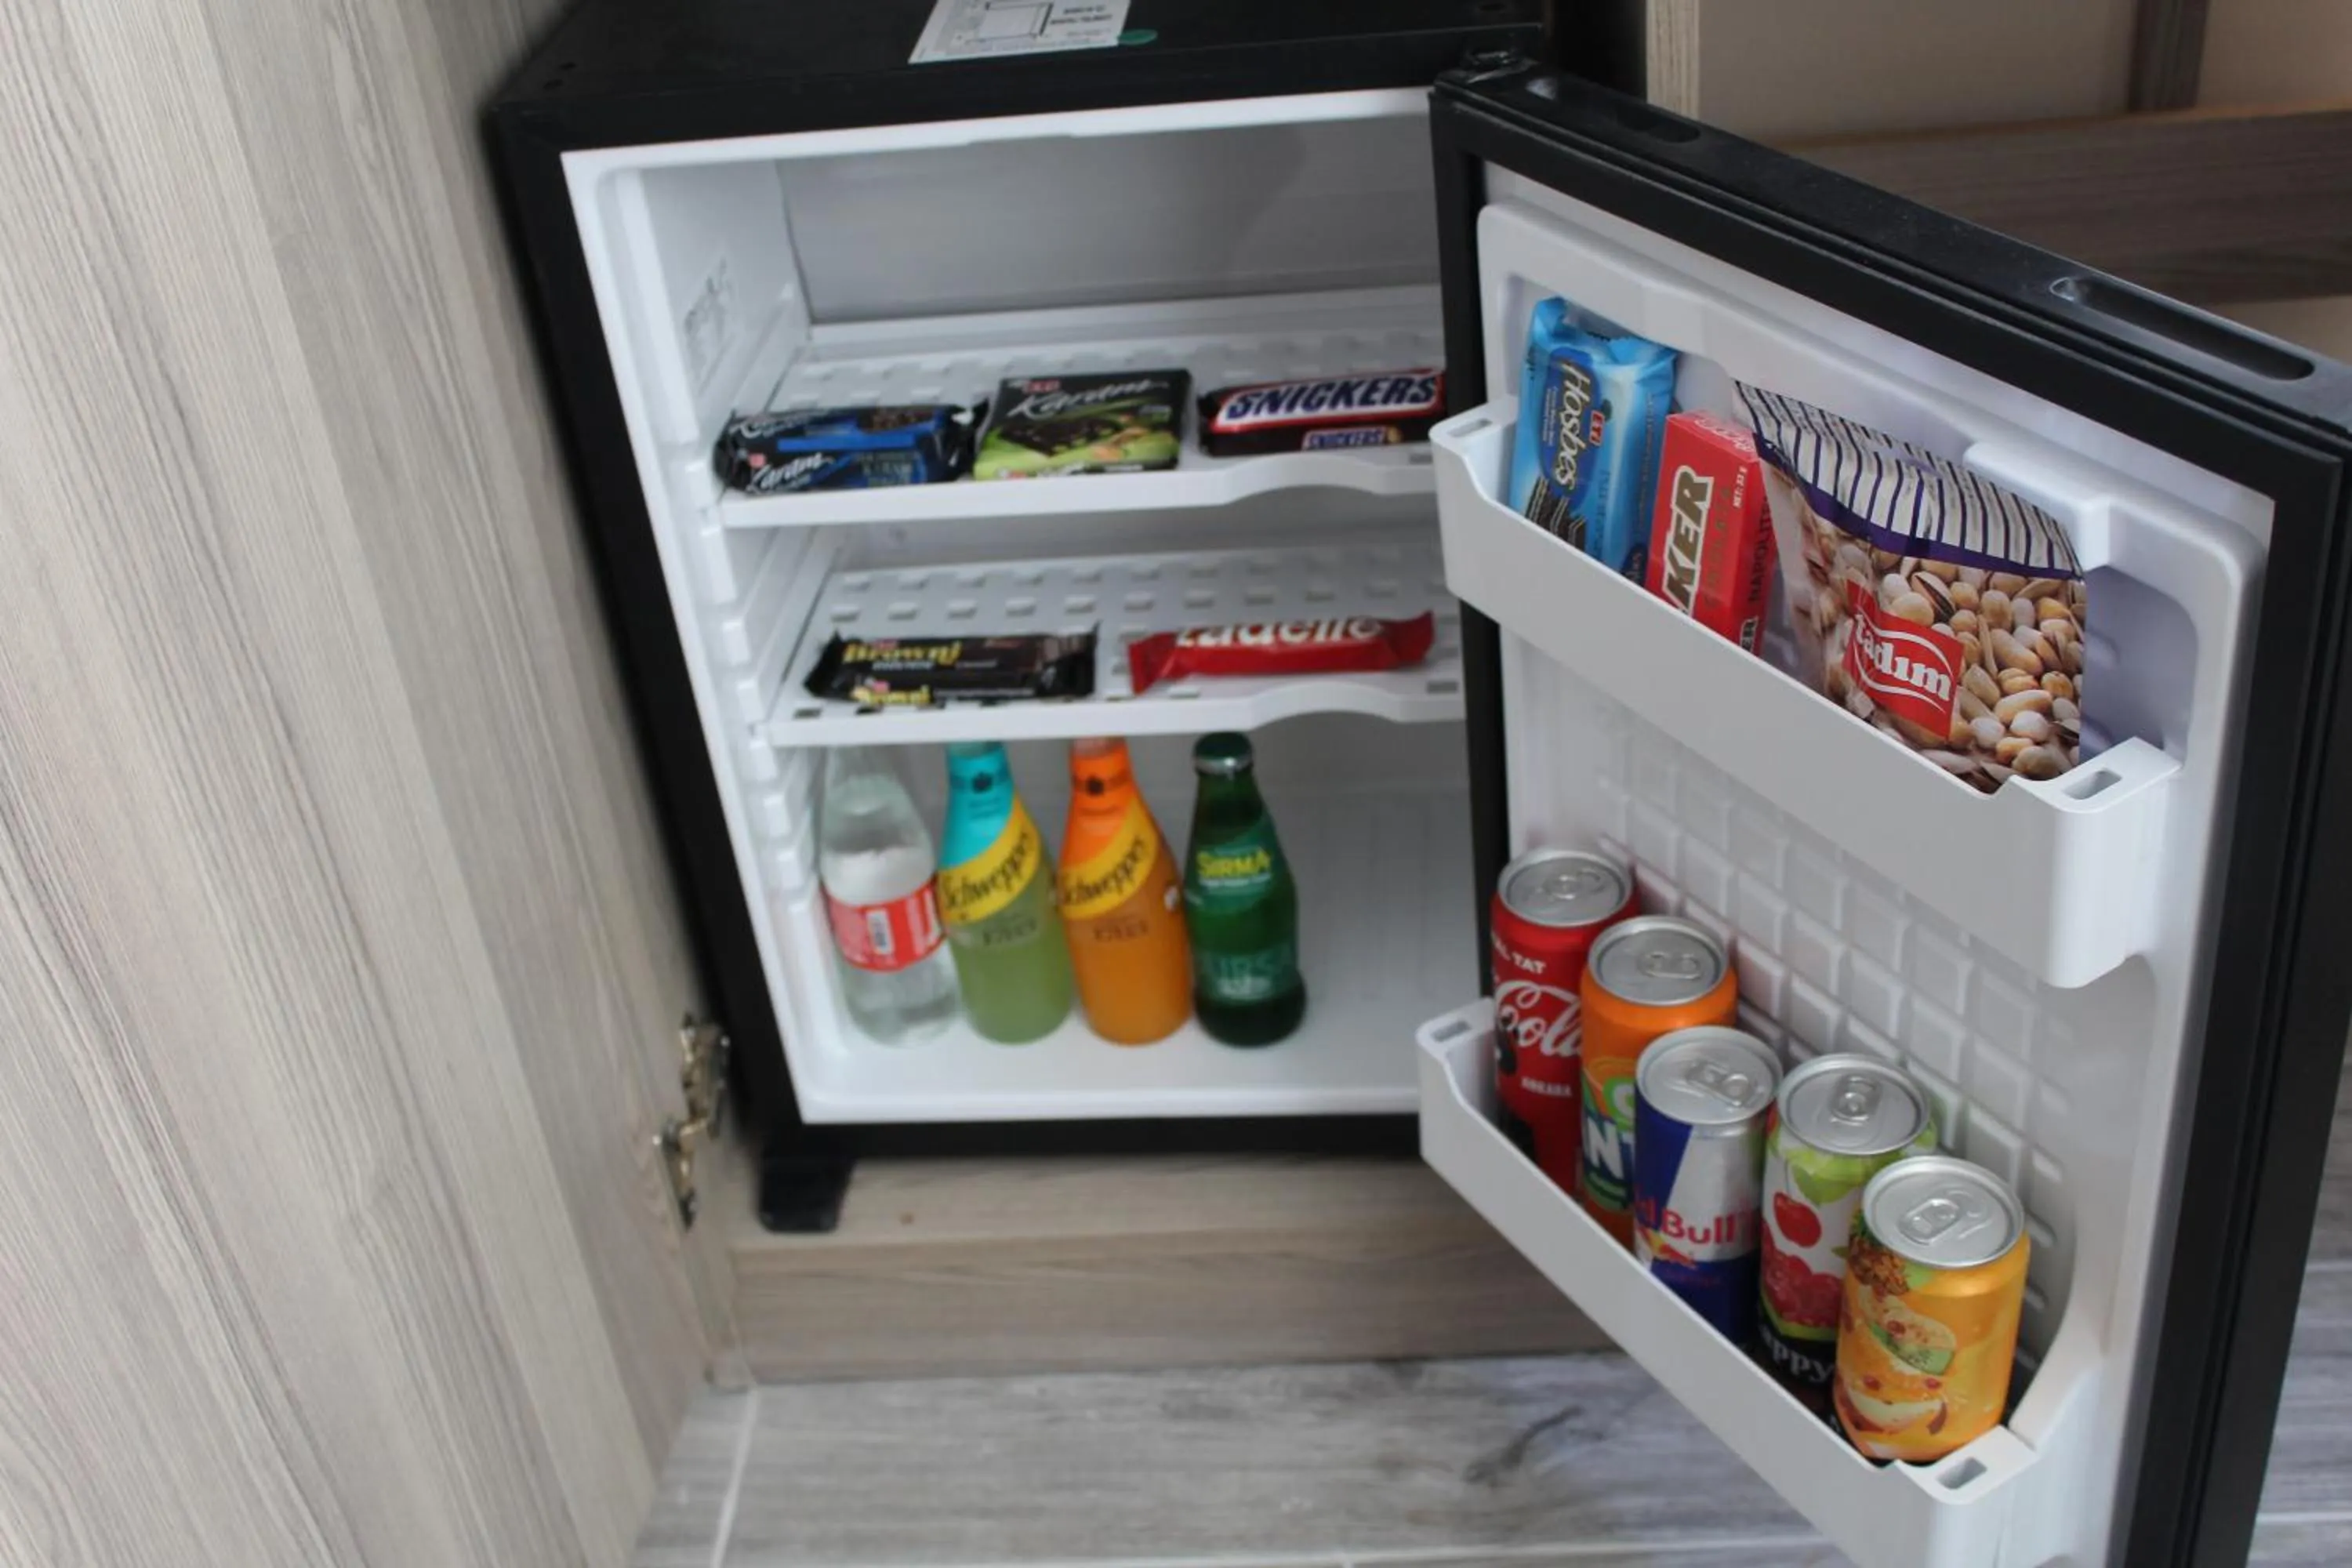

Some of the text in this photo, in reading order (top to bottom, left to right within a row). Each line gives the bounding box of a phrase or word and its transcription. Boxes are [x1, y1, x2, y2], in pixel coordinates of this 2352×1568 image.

[1225, 375, 1437, 420] SNICKERS
[1307, 428, 1385, 450] SNICKERS
[1662, 465, 1715, 615] KER
[1661, 1208, 1736, 1245] Bull
